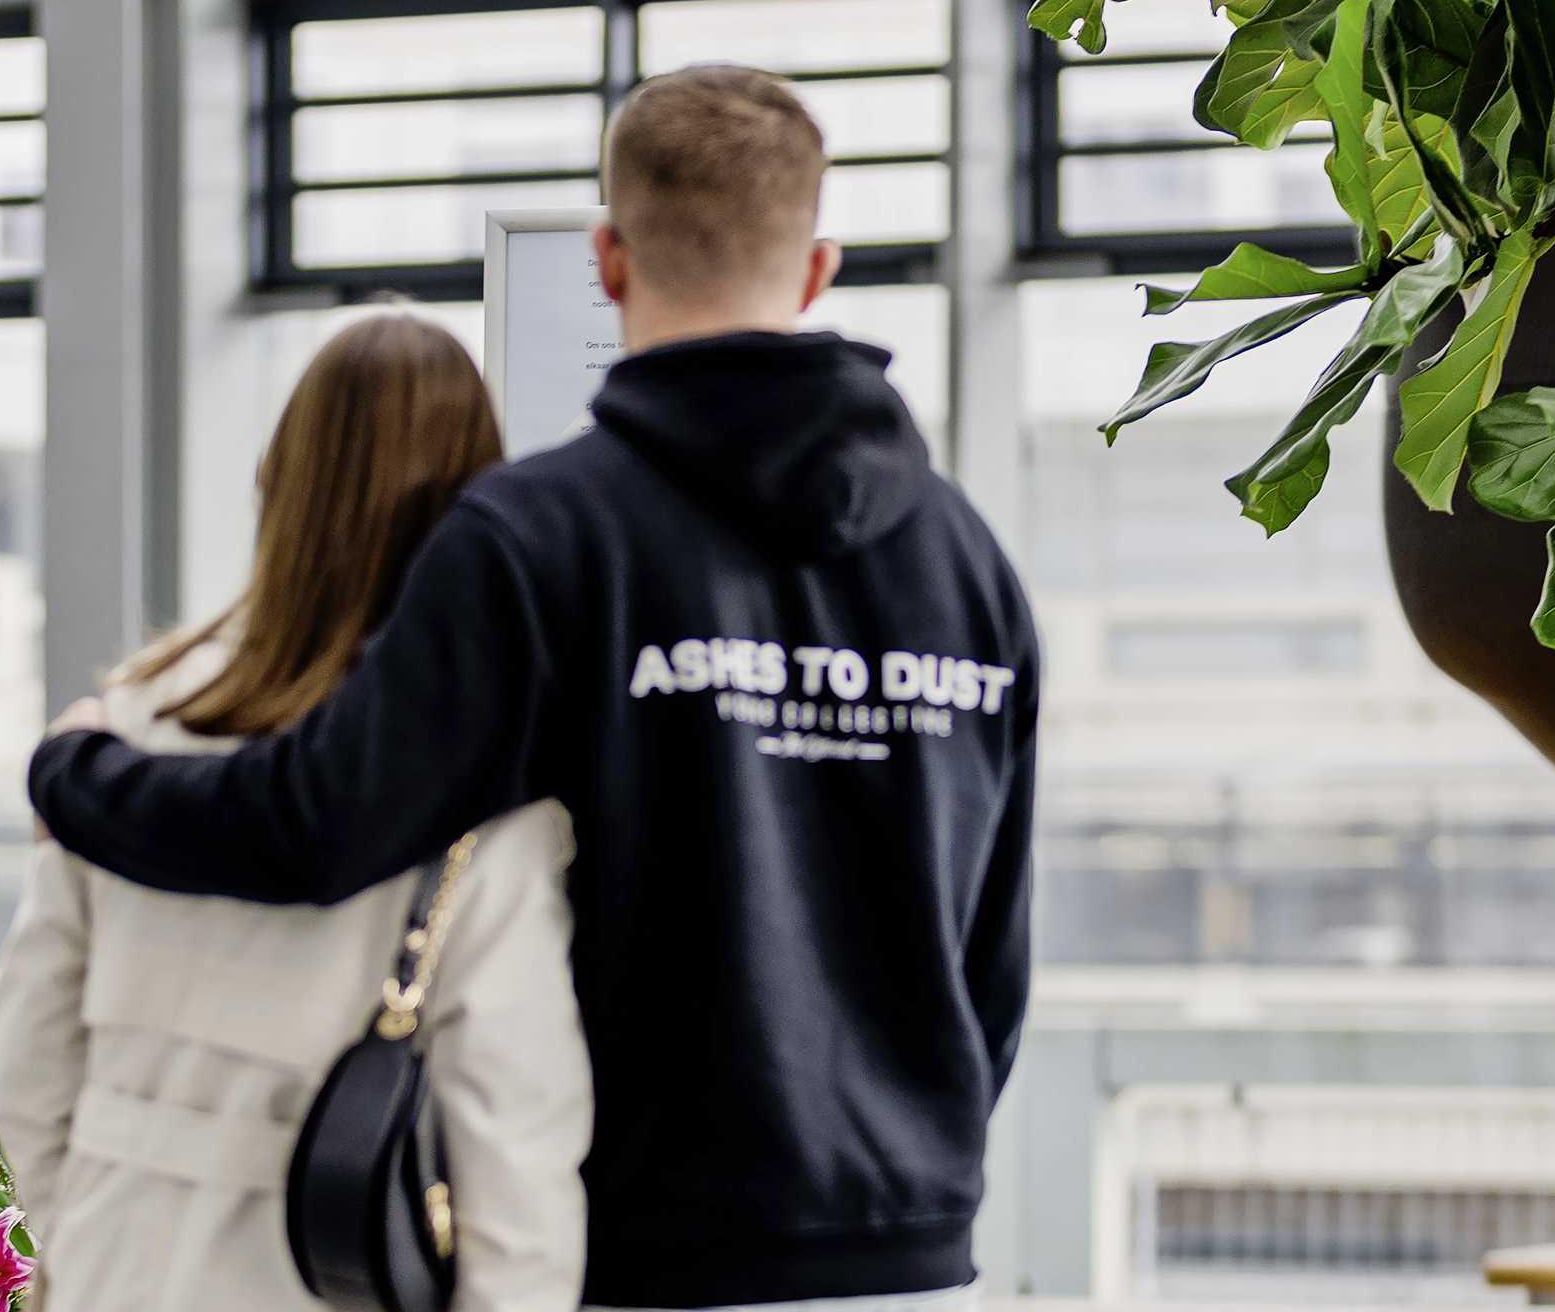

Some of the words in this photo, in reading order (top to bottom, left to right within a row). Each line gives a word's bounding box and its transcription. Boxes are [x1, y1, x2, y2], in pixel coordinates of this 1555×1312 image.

[629, 637, 788, 699] ASHES
[793, 646, 870, 701] TO
[881, 650, 1015, 716] DUST
